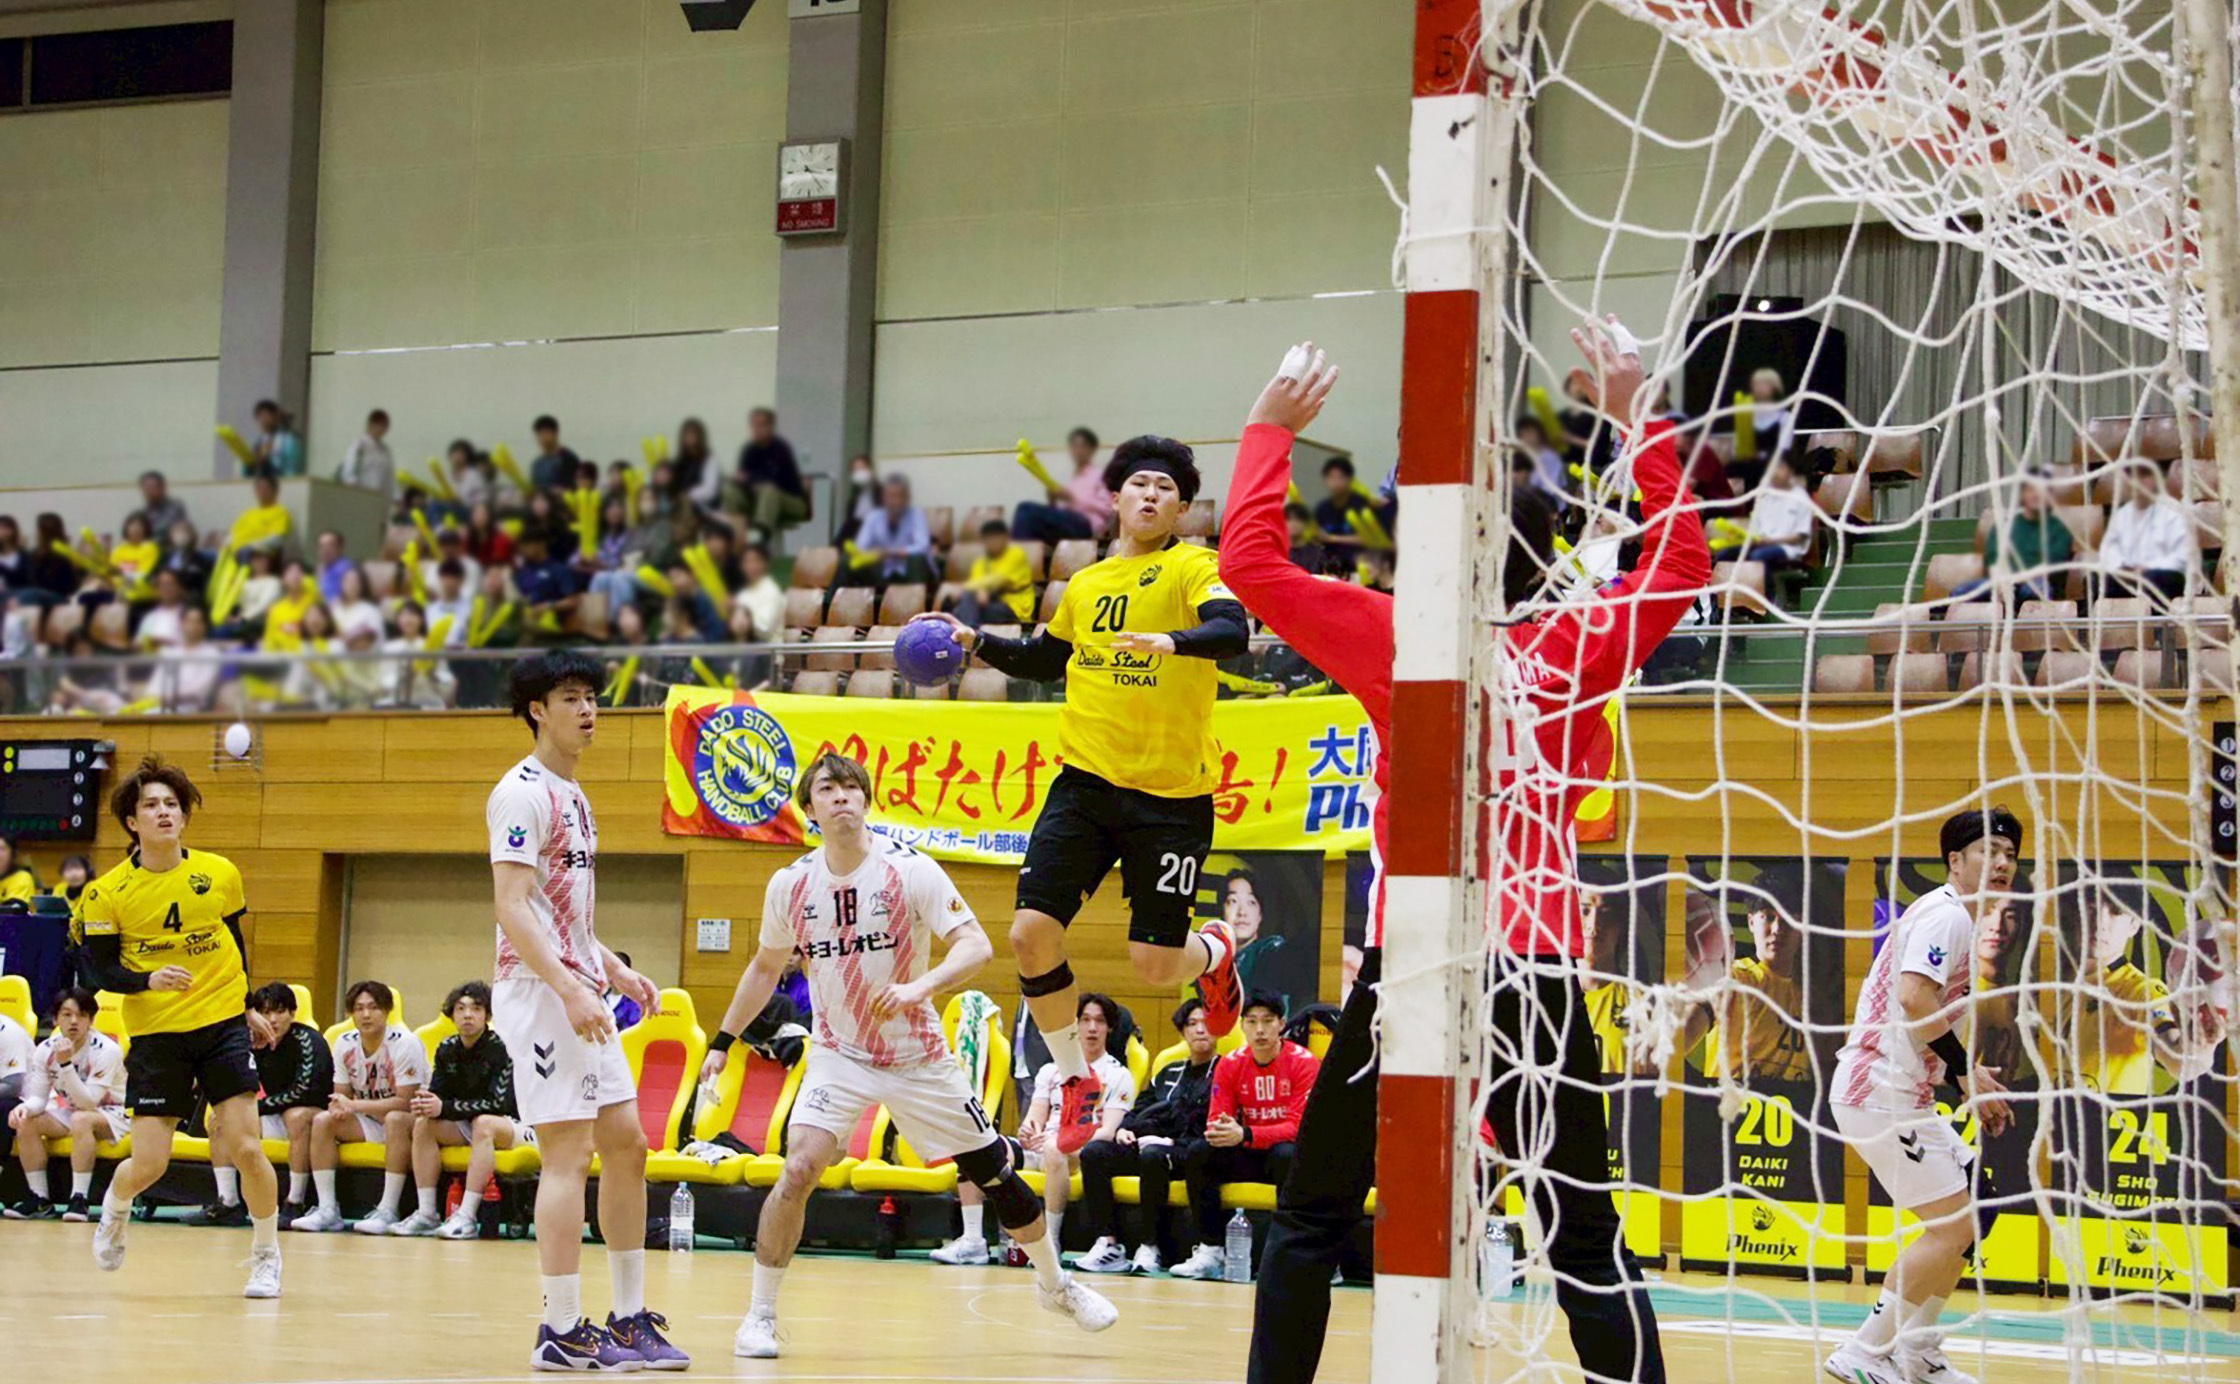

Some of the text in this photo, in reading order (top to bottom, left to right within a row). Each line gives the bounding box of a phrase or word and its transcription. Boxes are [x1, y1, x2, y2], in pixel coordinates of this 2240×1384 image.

[1092, 595, 1129, 632] 20
[1077, 648, 1153, 668] Daido Steel
[1113, 674, 1157, 687] TOKAI
[742, 709, 786, 758] STEEL
[698, 766, 793, 824] HANDBALL CLUB
[1156, 852, 1197, 896] 20
[163, 902, 182, 933] 4
[834, 888, 857, 927] 18
[806, 931, 898, 959] キヨーレオピン
[1255, 1075, 1275, 1101] 80
[964, 1096, 990, 1134] 18
[1735, 1095, 1793, 1147] 20
[2108, 1110, 2170, 1165] 24
[1739, 1155, 1789, 1170] DAIKI
[1741, 1173, 1785, 1188] KANI
[2117, 1175, 2158, 1189] SHO
[1726, 1233, 1798, 1261] Phenix
[2097, 1256, 2175, 1286] Phenix
